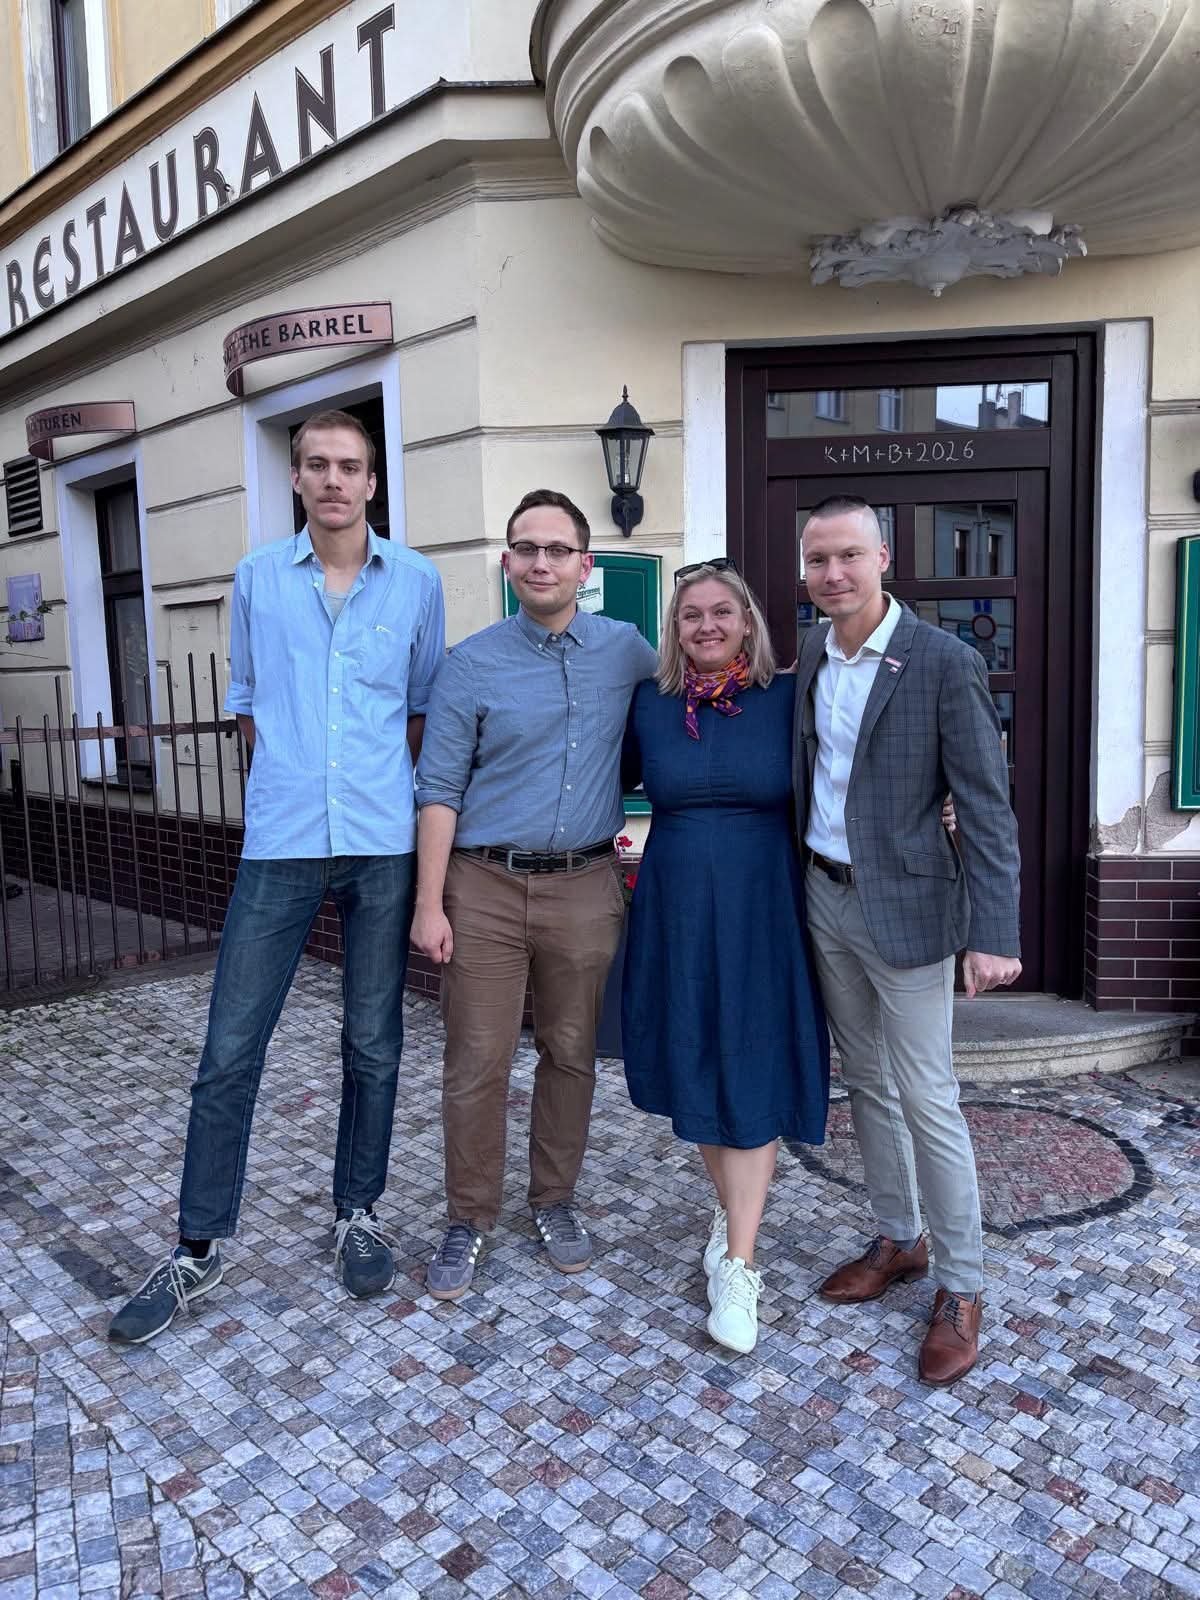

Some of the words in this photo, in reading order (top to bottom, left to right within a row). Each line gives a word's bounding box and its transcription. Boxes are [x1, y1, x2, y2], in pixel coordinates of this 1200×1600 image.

[6, 4, 396, 328] RESTAURANT
[240, 327, 271, 353] THE
[278, 314, 373, 343] BARREL
[824, 440, 974, 463] K+M+B+2026
